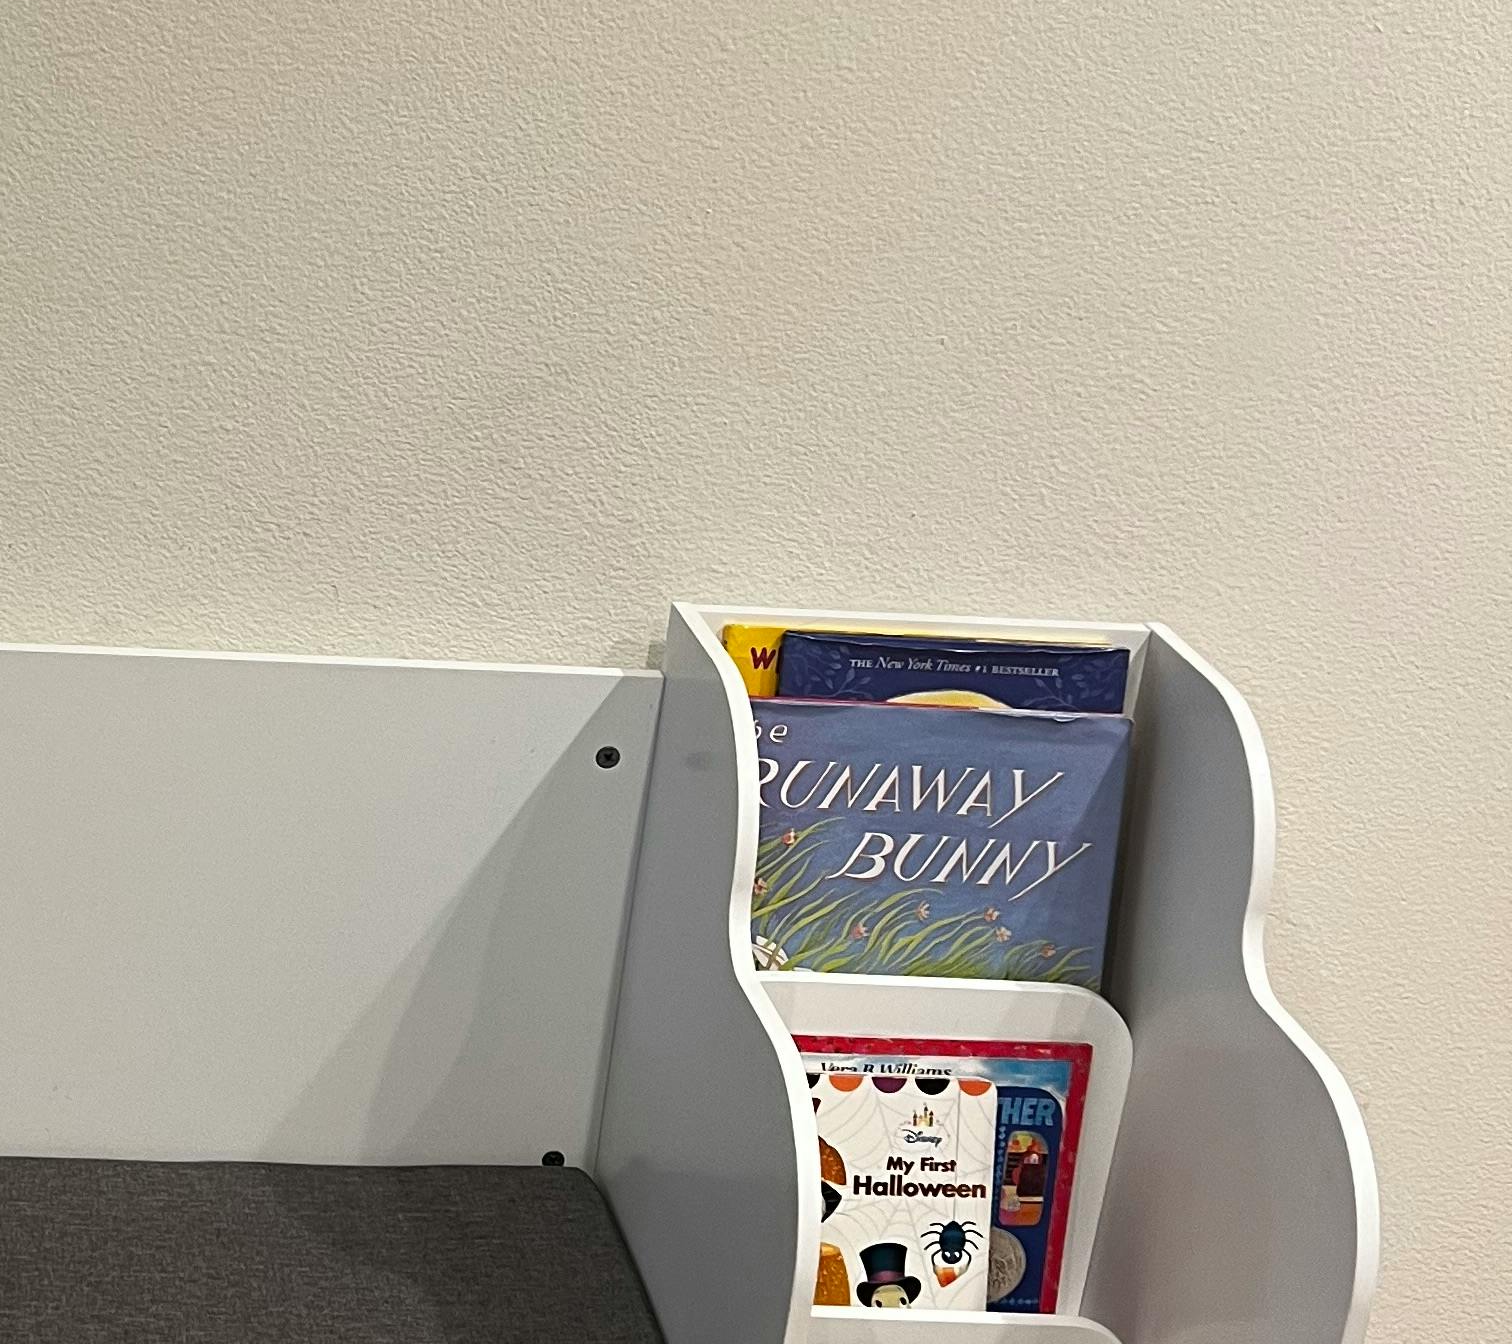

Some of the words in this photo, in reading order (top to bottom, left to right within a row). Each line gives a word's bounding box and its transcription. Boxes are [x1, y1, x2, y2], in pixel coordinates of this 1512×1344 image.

[849, 659, 873, 668] THE
[874, 657, 905, 669] New
[906, 657, 933, 671] York
[935, 659, 972, 673] Times
[991, 665, 1059, 677] BESTSELLER
[759, 757, 1065, 829] RUNAWAY
[825, 832, 1093, 902] BUNNY
[901, 1128, 943, 1148] Disney
[886, 1156, 915, 1175] My
[920, 1157, 957, 1172] First
[853, 1174, 986, 1198] Halloween
